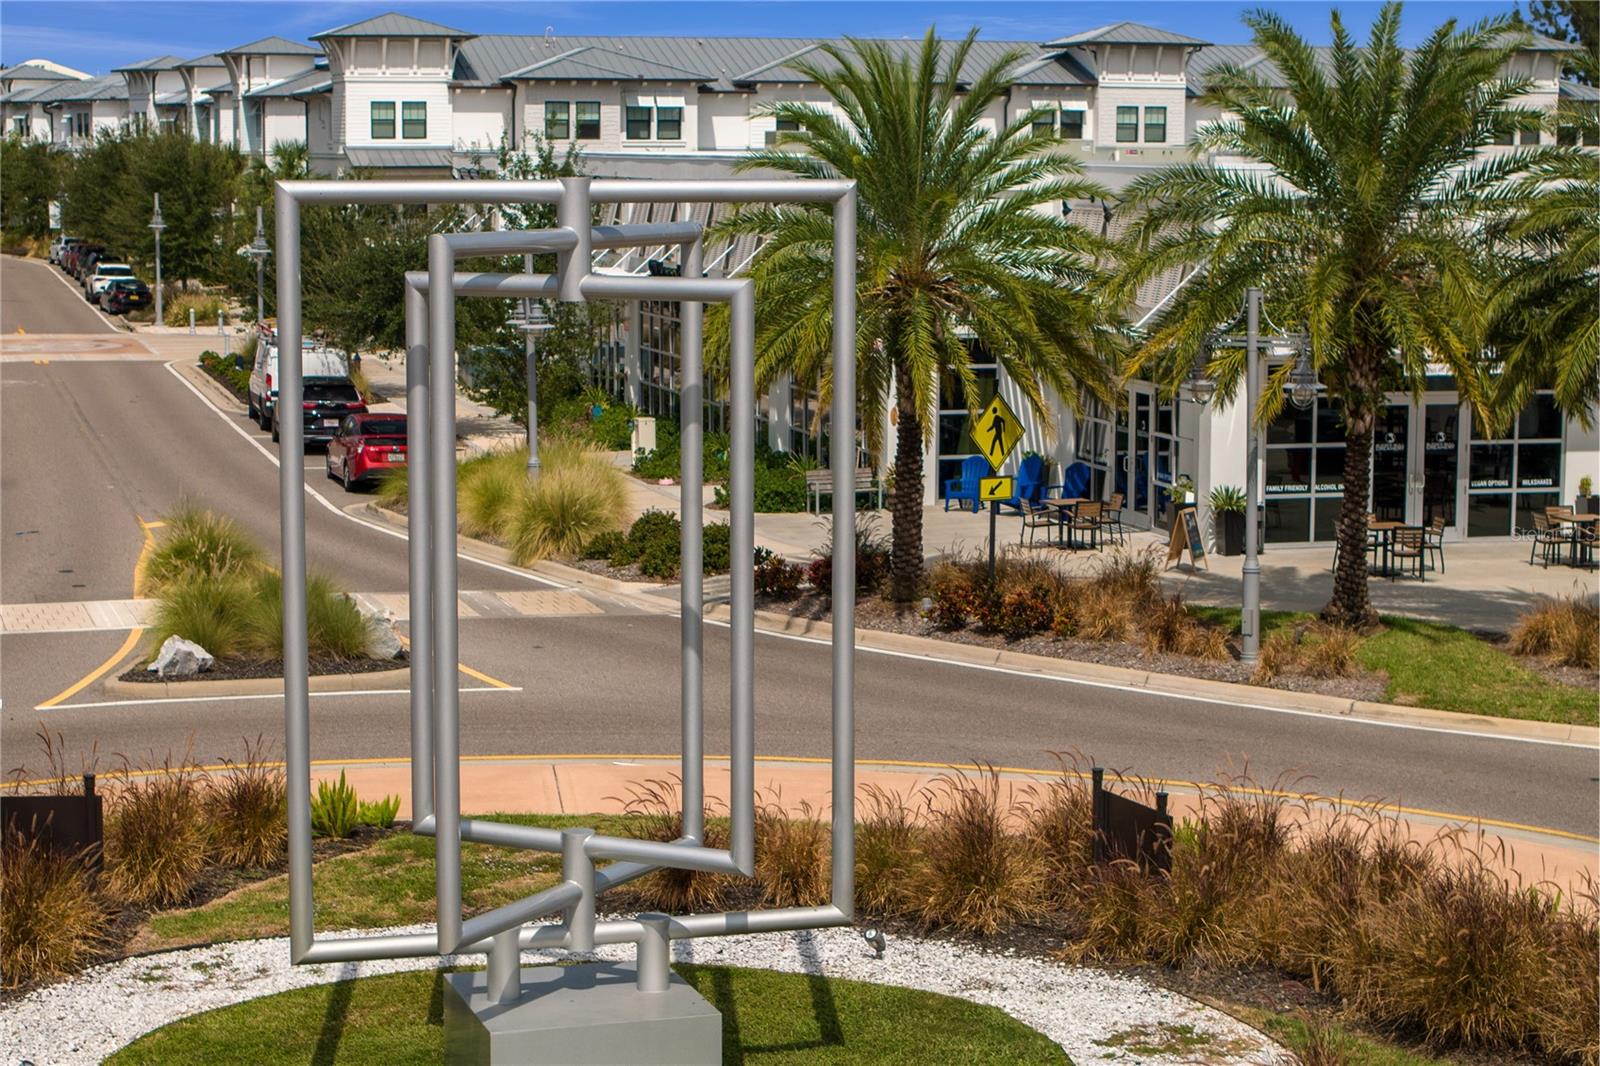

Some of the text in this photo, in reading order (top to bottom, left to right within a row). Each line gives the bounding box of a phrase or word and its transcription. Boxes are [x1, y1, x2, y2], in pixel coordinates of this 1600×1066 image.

[1266, 484, 1308, 492] FAMILY FRIENDLY
[1315, 483, 1337, 491] ALCOHOL
